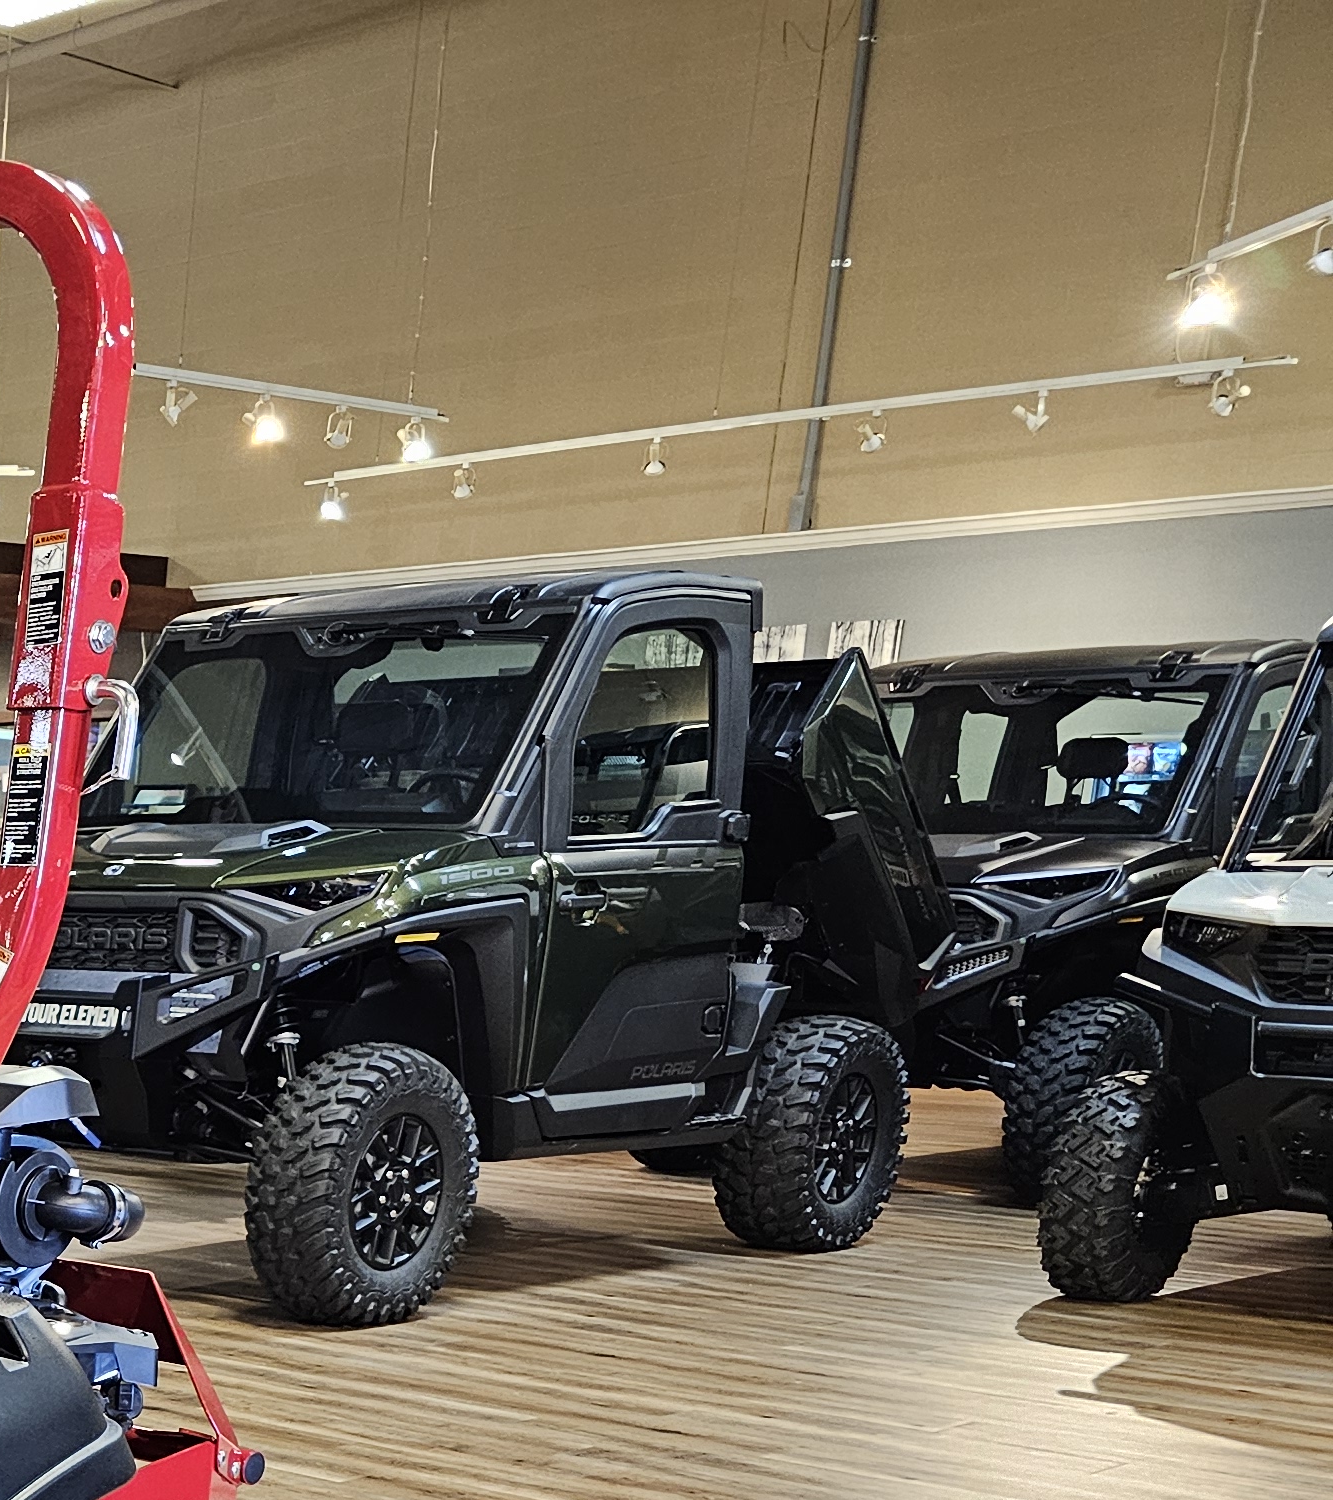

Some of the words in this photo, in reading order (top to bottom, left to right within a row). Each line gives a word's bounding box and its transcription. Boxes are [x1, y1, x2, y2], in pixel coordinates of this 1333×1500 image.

[440, 865, 514, 885] 1500
[56, 927, 168, 949] OLARIS
[630, 1061, 696, 1080] POLARIS
